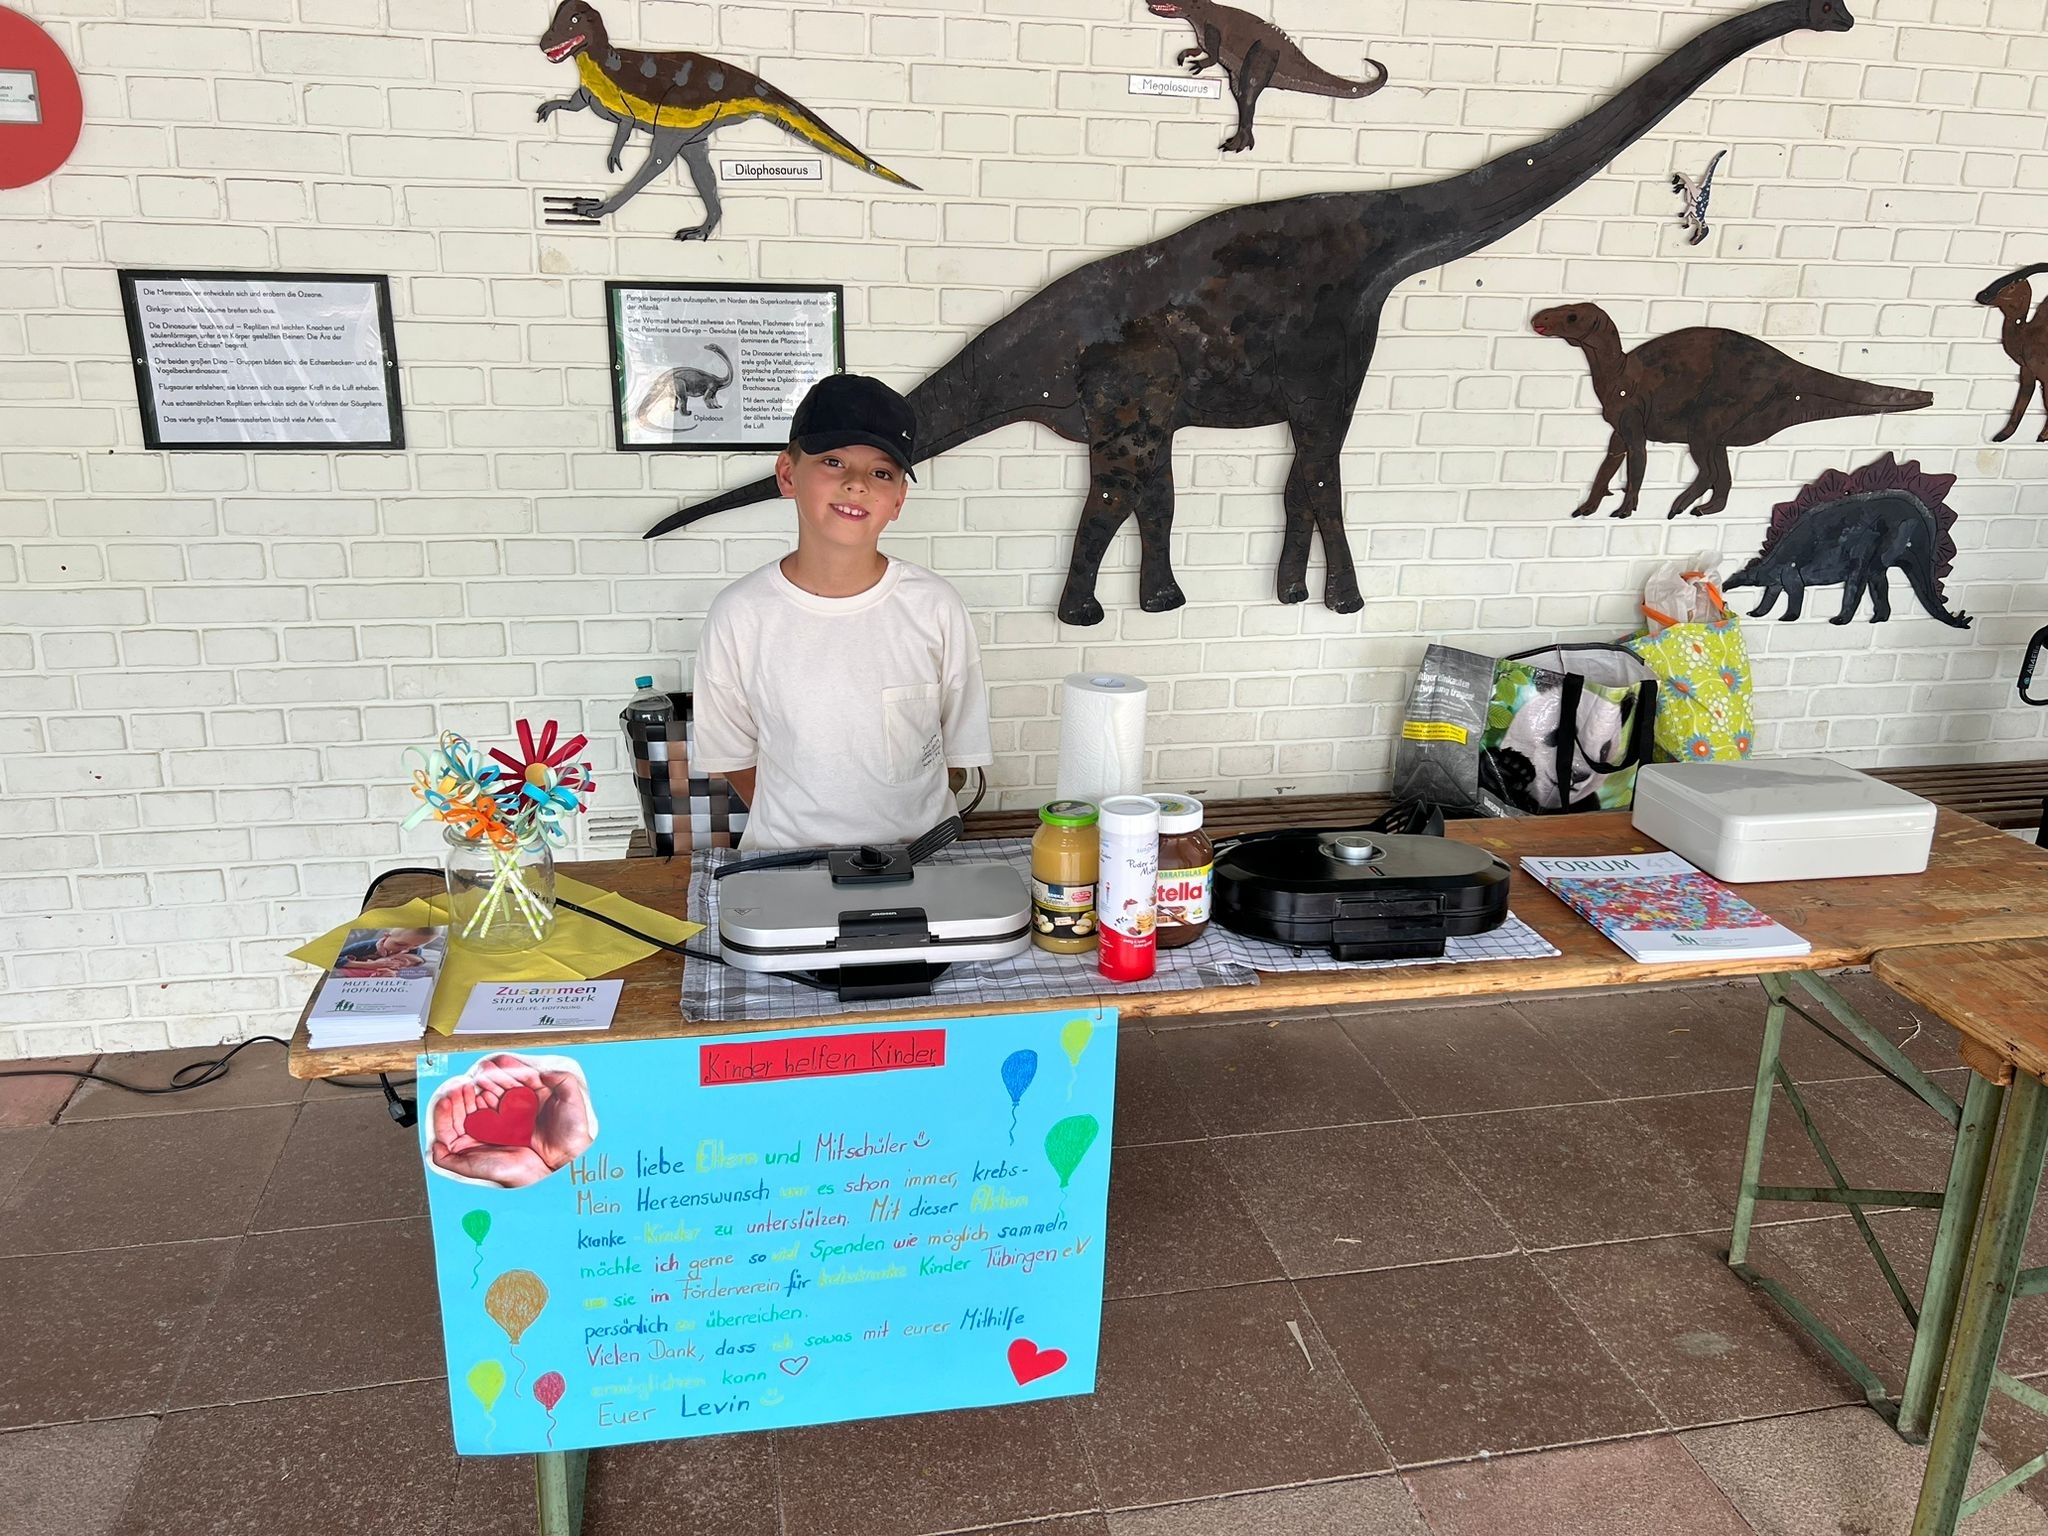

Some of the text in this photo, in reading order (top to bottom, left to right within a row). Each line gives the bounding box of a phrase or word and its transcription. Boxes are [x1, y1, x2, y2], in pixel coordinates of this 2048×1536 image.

[1142, 79, 1208, 94] Megalosaurus
[735, 164, 808, 179] Dilophosaurus
[1158, 869, 1202, 880] ORRATSGLAS
[1538, 858, 1640, 872] FORUM
[1156, 882, 1202, 902] tella
[492, 994, 595, 1004] sind wir stark
[496, 986, 597, 996] Zusammen
[707, 1037, 937, 1080] Kinder helfen Kinder
[570, 1158, 624, 1186] Hallo
[637, 1149, 685, 1178] liebe
[765, 1140, 801, 1165] und
[814, 1132, 909, 1163] Mitschüler
[577, 1190, 622, 1215] Mein
[637, 1178, 770, 1212] Herzenswunsch
[817, 1183, 835, 1196] es
[844, 1173, 890, 1193] schon
[904, 1168, 958, 1189] immer,
[972, 1160, 1028, 1182] krebs-
[578, 1230, 627, 1250] kranke
[714, 1225, 733, 1236] zu
[747, 1206, 850, 1234] unterstützen.
[870, 1194, 902, 1223] Mit
[909, 1198, 960, 1218] dieser
[580, 1256, 643, 1279] möchte
[655, 1253, 680, 1272] ich
[688, 1254, 734, 1280] gerne
[748, 1254, 767, 1264] so
[810, 1238, 885, 1263] Spenden
[893, 1234, 919, 1250] wie
[927, 1224, 990, 1251] möglich
[998, 1214, 1068, 1239] sammeln
[613, 1293, 637, 1307] sie
[650, 1289, 670, 1304] im
[676, 1277, 780, 1300] Förderverein
[784, 1269, 811, 1297] für
[920, 1256, 972, 1276] Kinder
[980, 1244, 1058, 1274] Tübingen
[584, 1314, 668, 1344] persönlich
[706, 1304, 808, 1328] überreichen.
[587, 1343, 640, 1366] Vielen
[648, 1338, 704, 1362] Dank,
[715, 1339, 756, 1356] dass
[804, 1332, 852, 1347] sowas
[864, 1320, 889, 1341] mit
[903, 1322, 951, 1336] eurer
[960, 1306, 1025, 1332] Mithilfe
[722, 1370, 767, 1385] kann
[598, 1394, 750, 1427] Euer Levin
